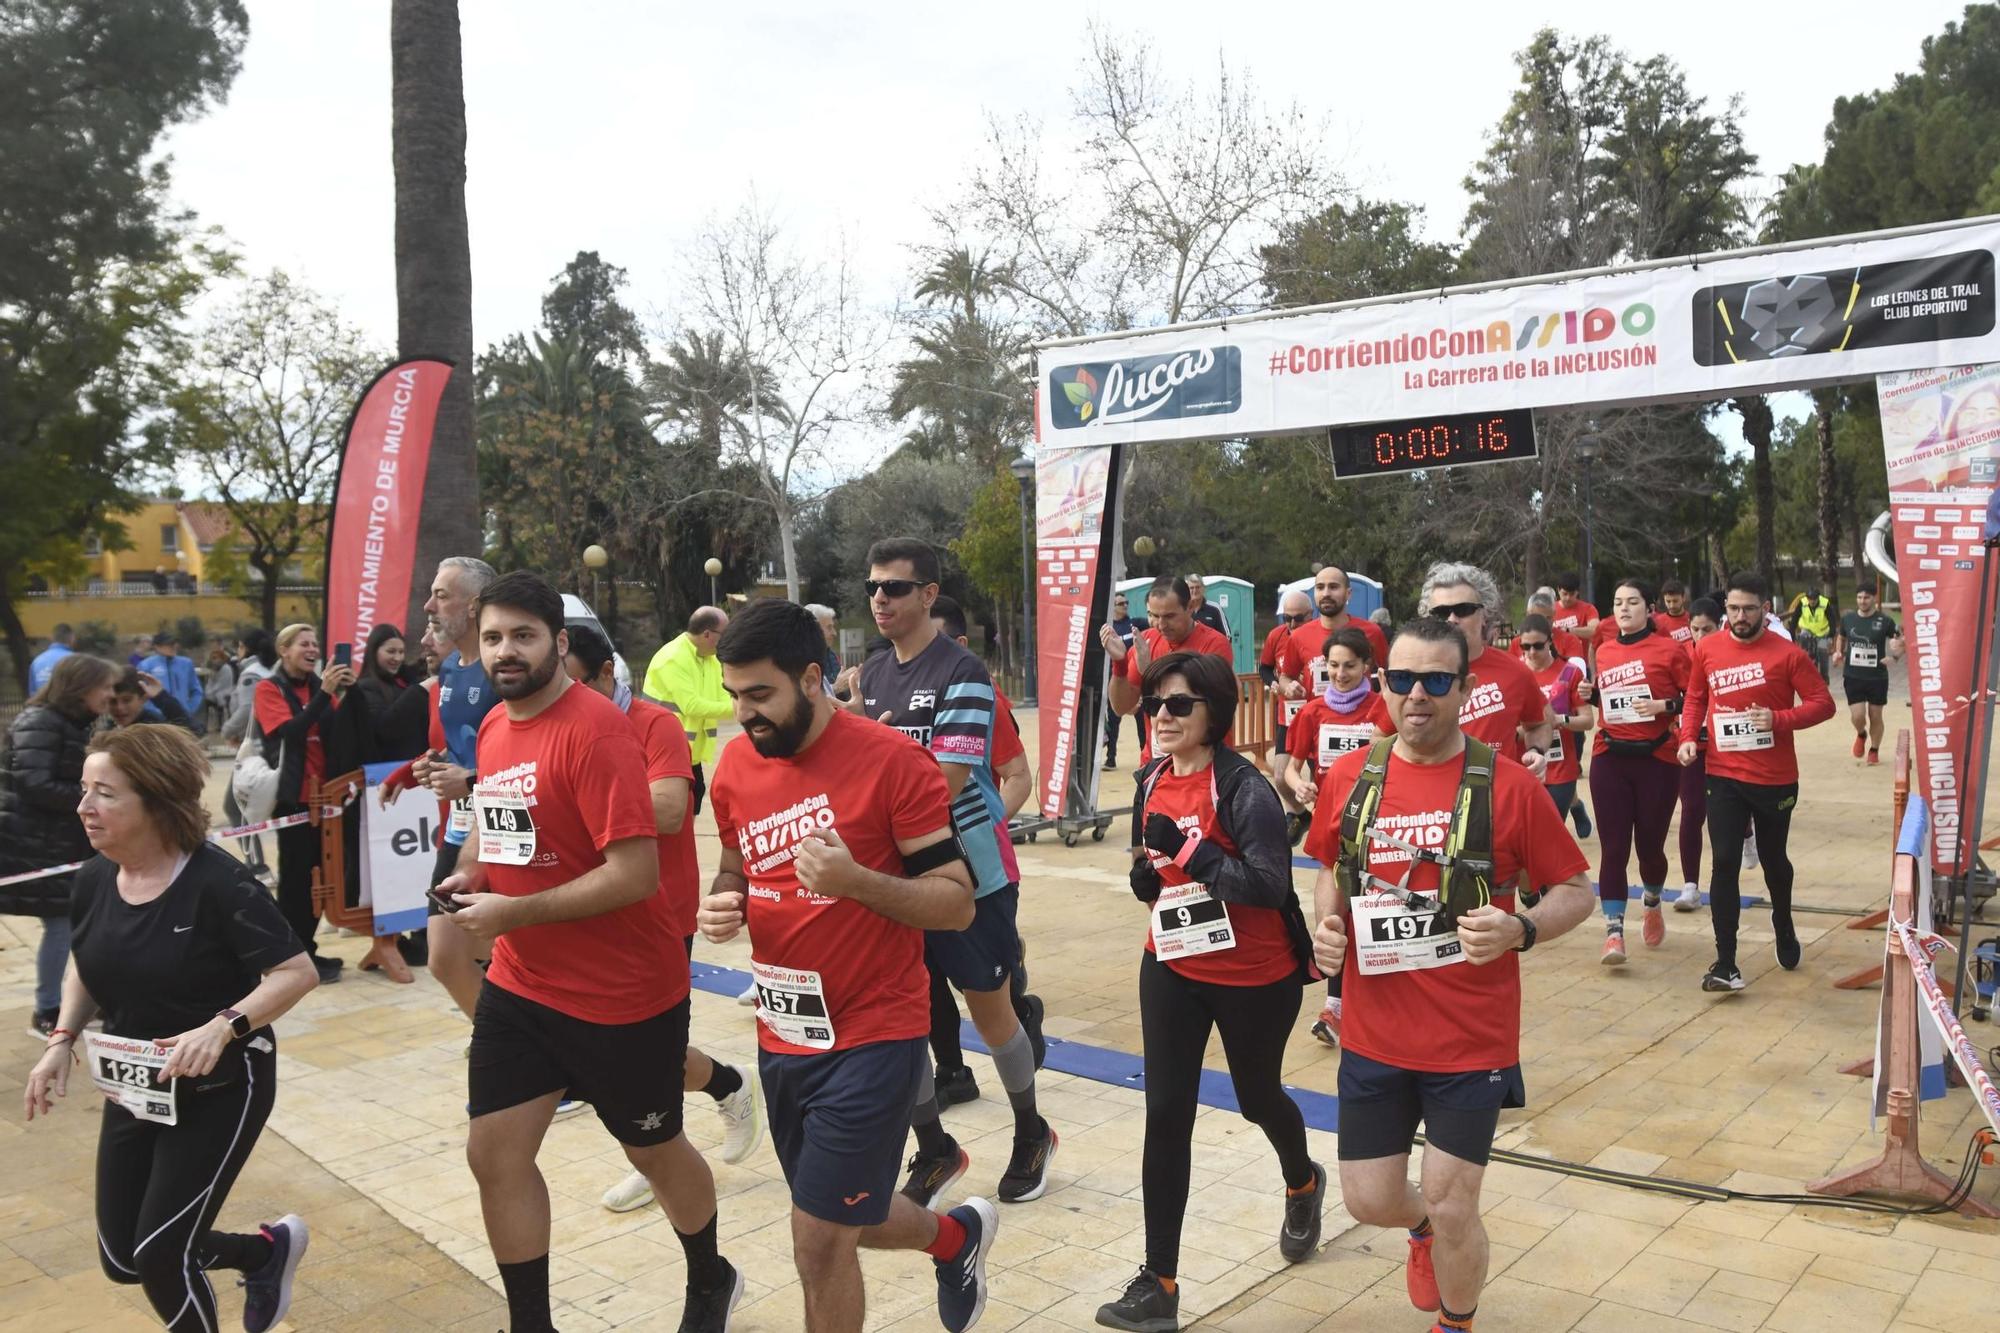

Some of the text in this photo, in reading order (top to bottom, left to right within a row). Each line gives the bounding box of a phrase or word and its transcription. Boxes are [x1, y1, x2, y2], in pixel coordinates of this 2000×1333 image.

[1871, 283, 1981, 308] LOS LEONES DEL TRAIL
[1884, 299, 1968, 320] CLUB DEPORTIVO
[1404, 343, 1657, 390] La Carrera de la INCLUSIÓN
[353, 367, 417, 664] AYUNTAMIENTO DE MURCIA
[1911, 581, 1937, 605] La
[1914, 608, 1942, 692] Carrera
[1044, 604, 1088, 813] La Carrera de la INCLUSIÓN
[1922, 697, 1948, 724] de
[943, 735, 985, 746] HERBALIFE
[1728, 723, 1758, 735] 156
[1925, 727, 1950, 748] la
[943, 740, 985, 751] NUTRITION
[1339, 738, 1360, 750] 55
[489, 807, 518, 832] 149
[1928, 752, 1966, 864] INCLUSIÓN
[1373, 825, 1449, 849] ASSID
[1369, 850, 1413, 865] CARRERA
[1176, 906, 1192, 927] 9
[1381, 914, 1435, 940] 197
[761, 987, 800, 1014] 157
[107, 1060, 150, 1089] 128
